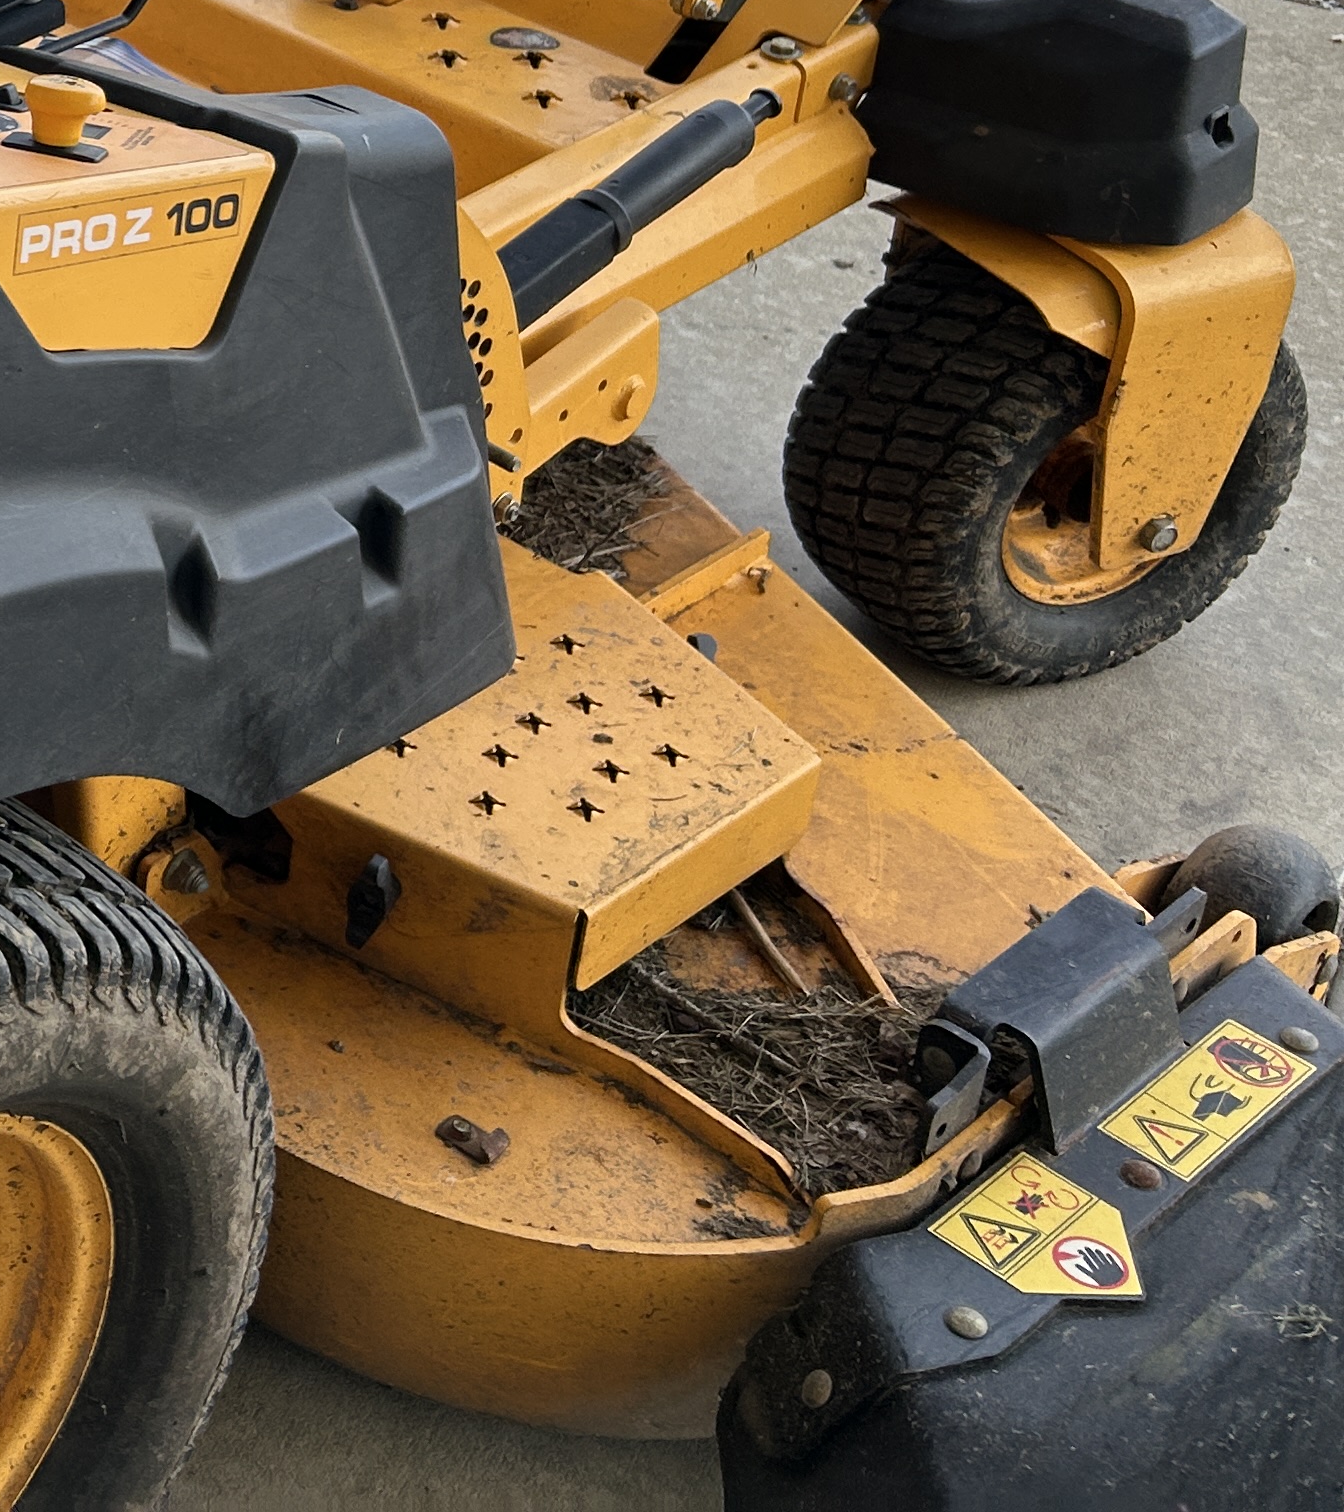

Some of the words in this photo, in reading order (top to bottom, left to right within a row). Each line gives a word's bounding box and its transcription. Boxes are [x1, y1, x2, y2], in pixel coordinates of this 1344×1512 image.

[20, 213, 117, 264] PRO
[123, 207, 154, 246] Z
[166, 193, 240, 237] 100
